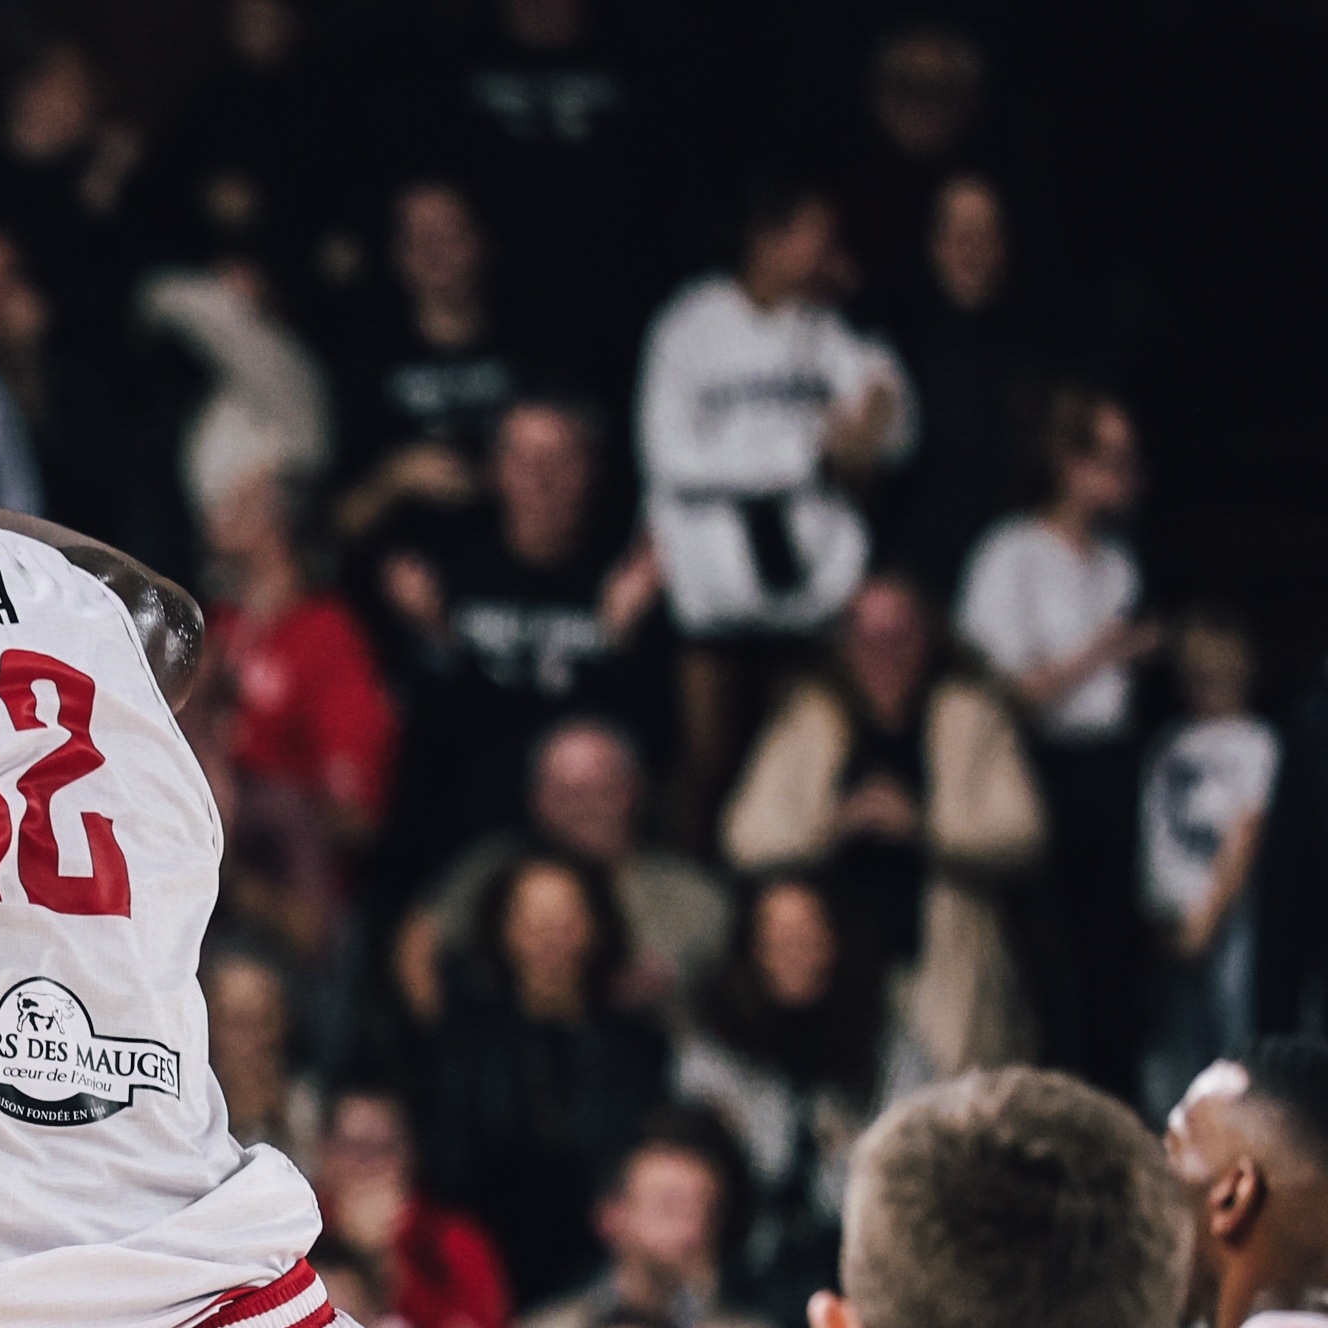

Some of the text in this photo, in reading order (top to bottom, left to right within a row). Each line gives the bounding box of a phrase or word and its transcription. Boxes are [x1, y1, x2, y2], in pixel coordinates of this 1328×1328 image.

[26, 1037, 69, 1063] DES
[75, 1042, 177, 1088] MAUGES
[1, 1067, 45, 1081] cœur
[46, 1068, 68, 1083] de
[26, 1105, 72, 1122] FONDÉE
[72, 1108, 89, 1121] EN
